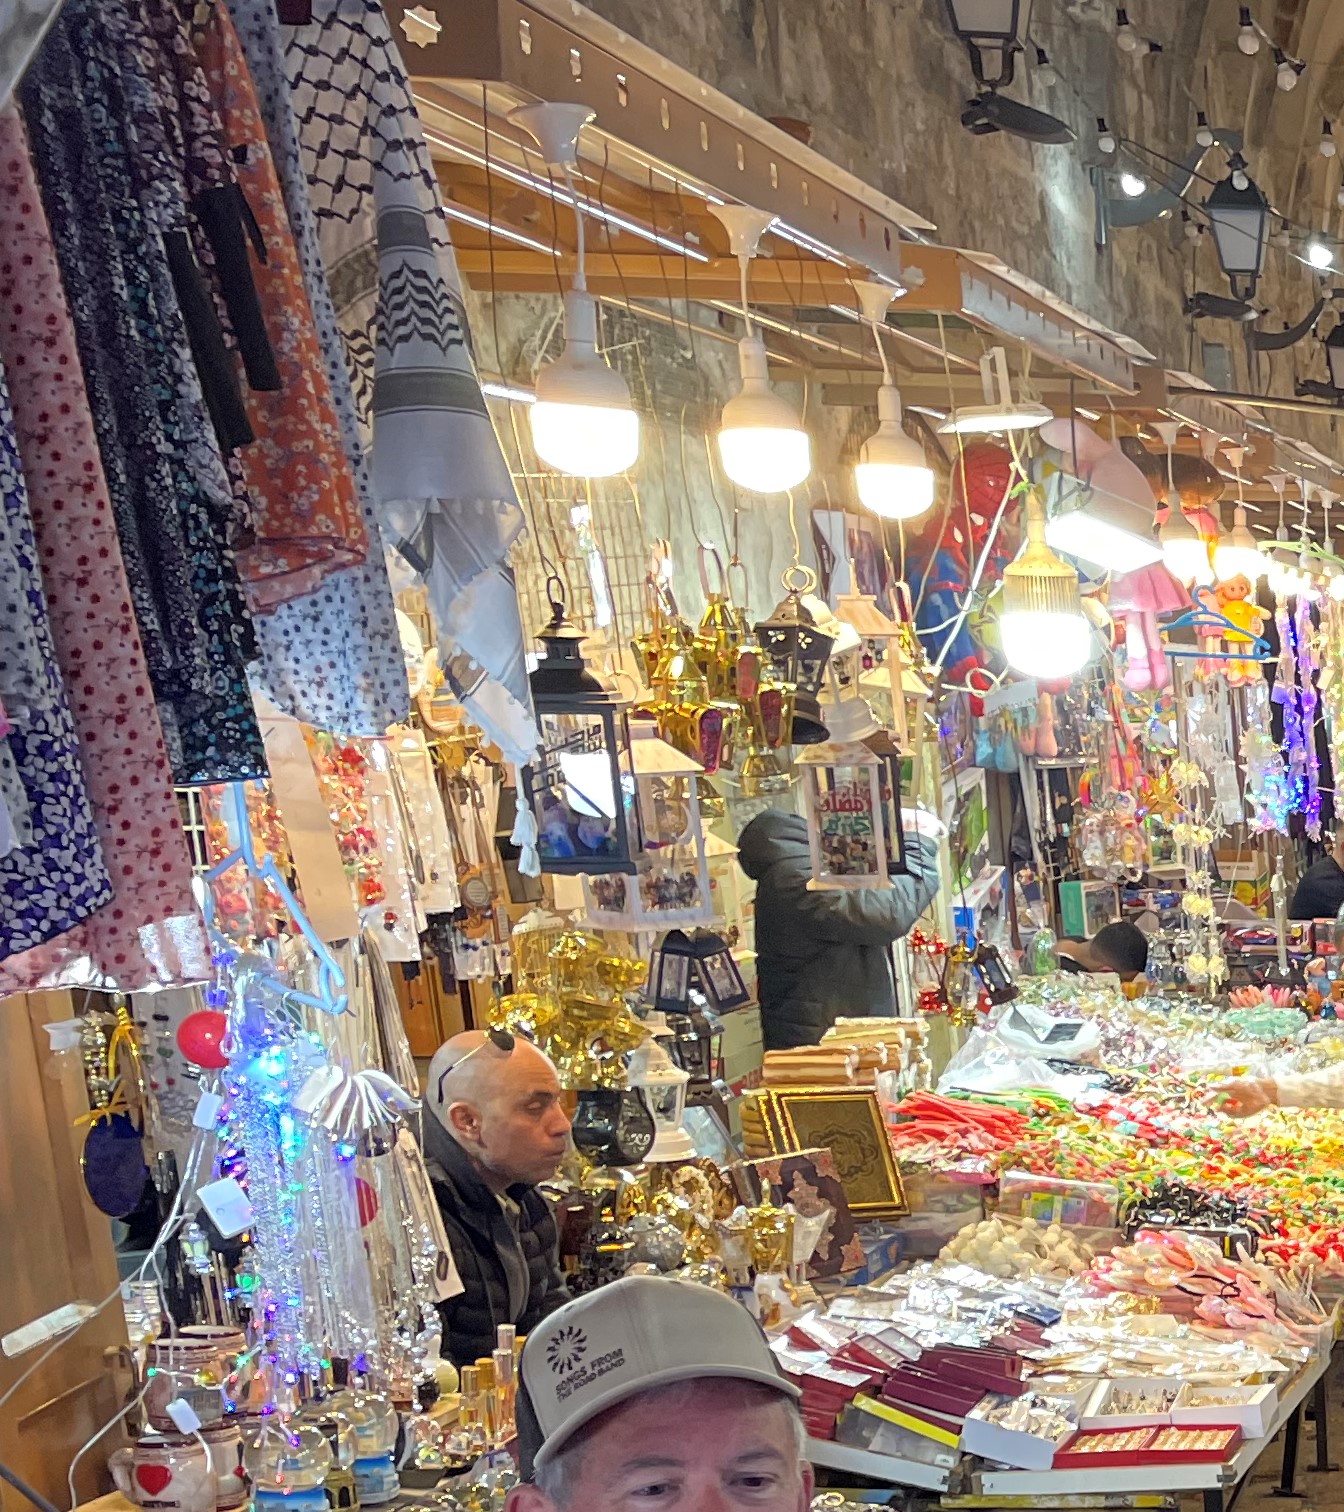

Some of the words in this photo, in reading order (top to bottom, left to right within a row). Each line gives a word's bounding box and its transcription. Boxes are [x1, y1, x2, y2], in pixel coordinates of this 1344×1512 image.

[556, 1366, 587, 1392] SONGS
[590, 1348, 623, 1370] FROM
[557, 1388, 573, 1402] THE
[574, 1372, 597, 1391] ROAD
[597, 1358, 625, 1376] BAND
